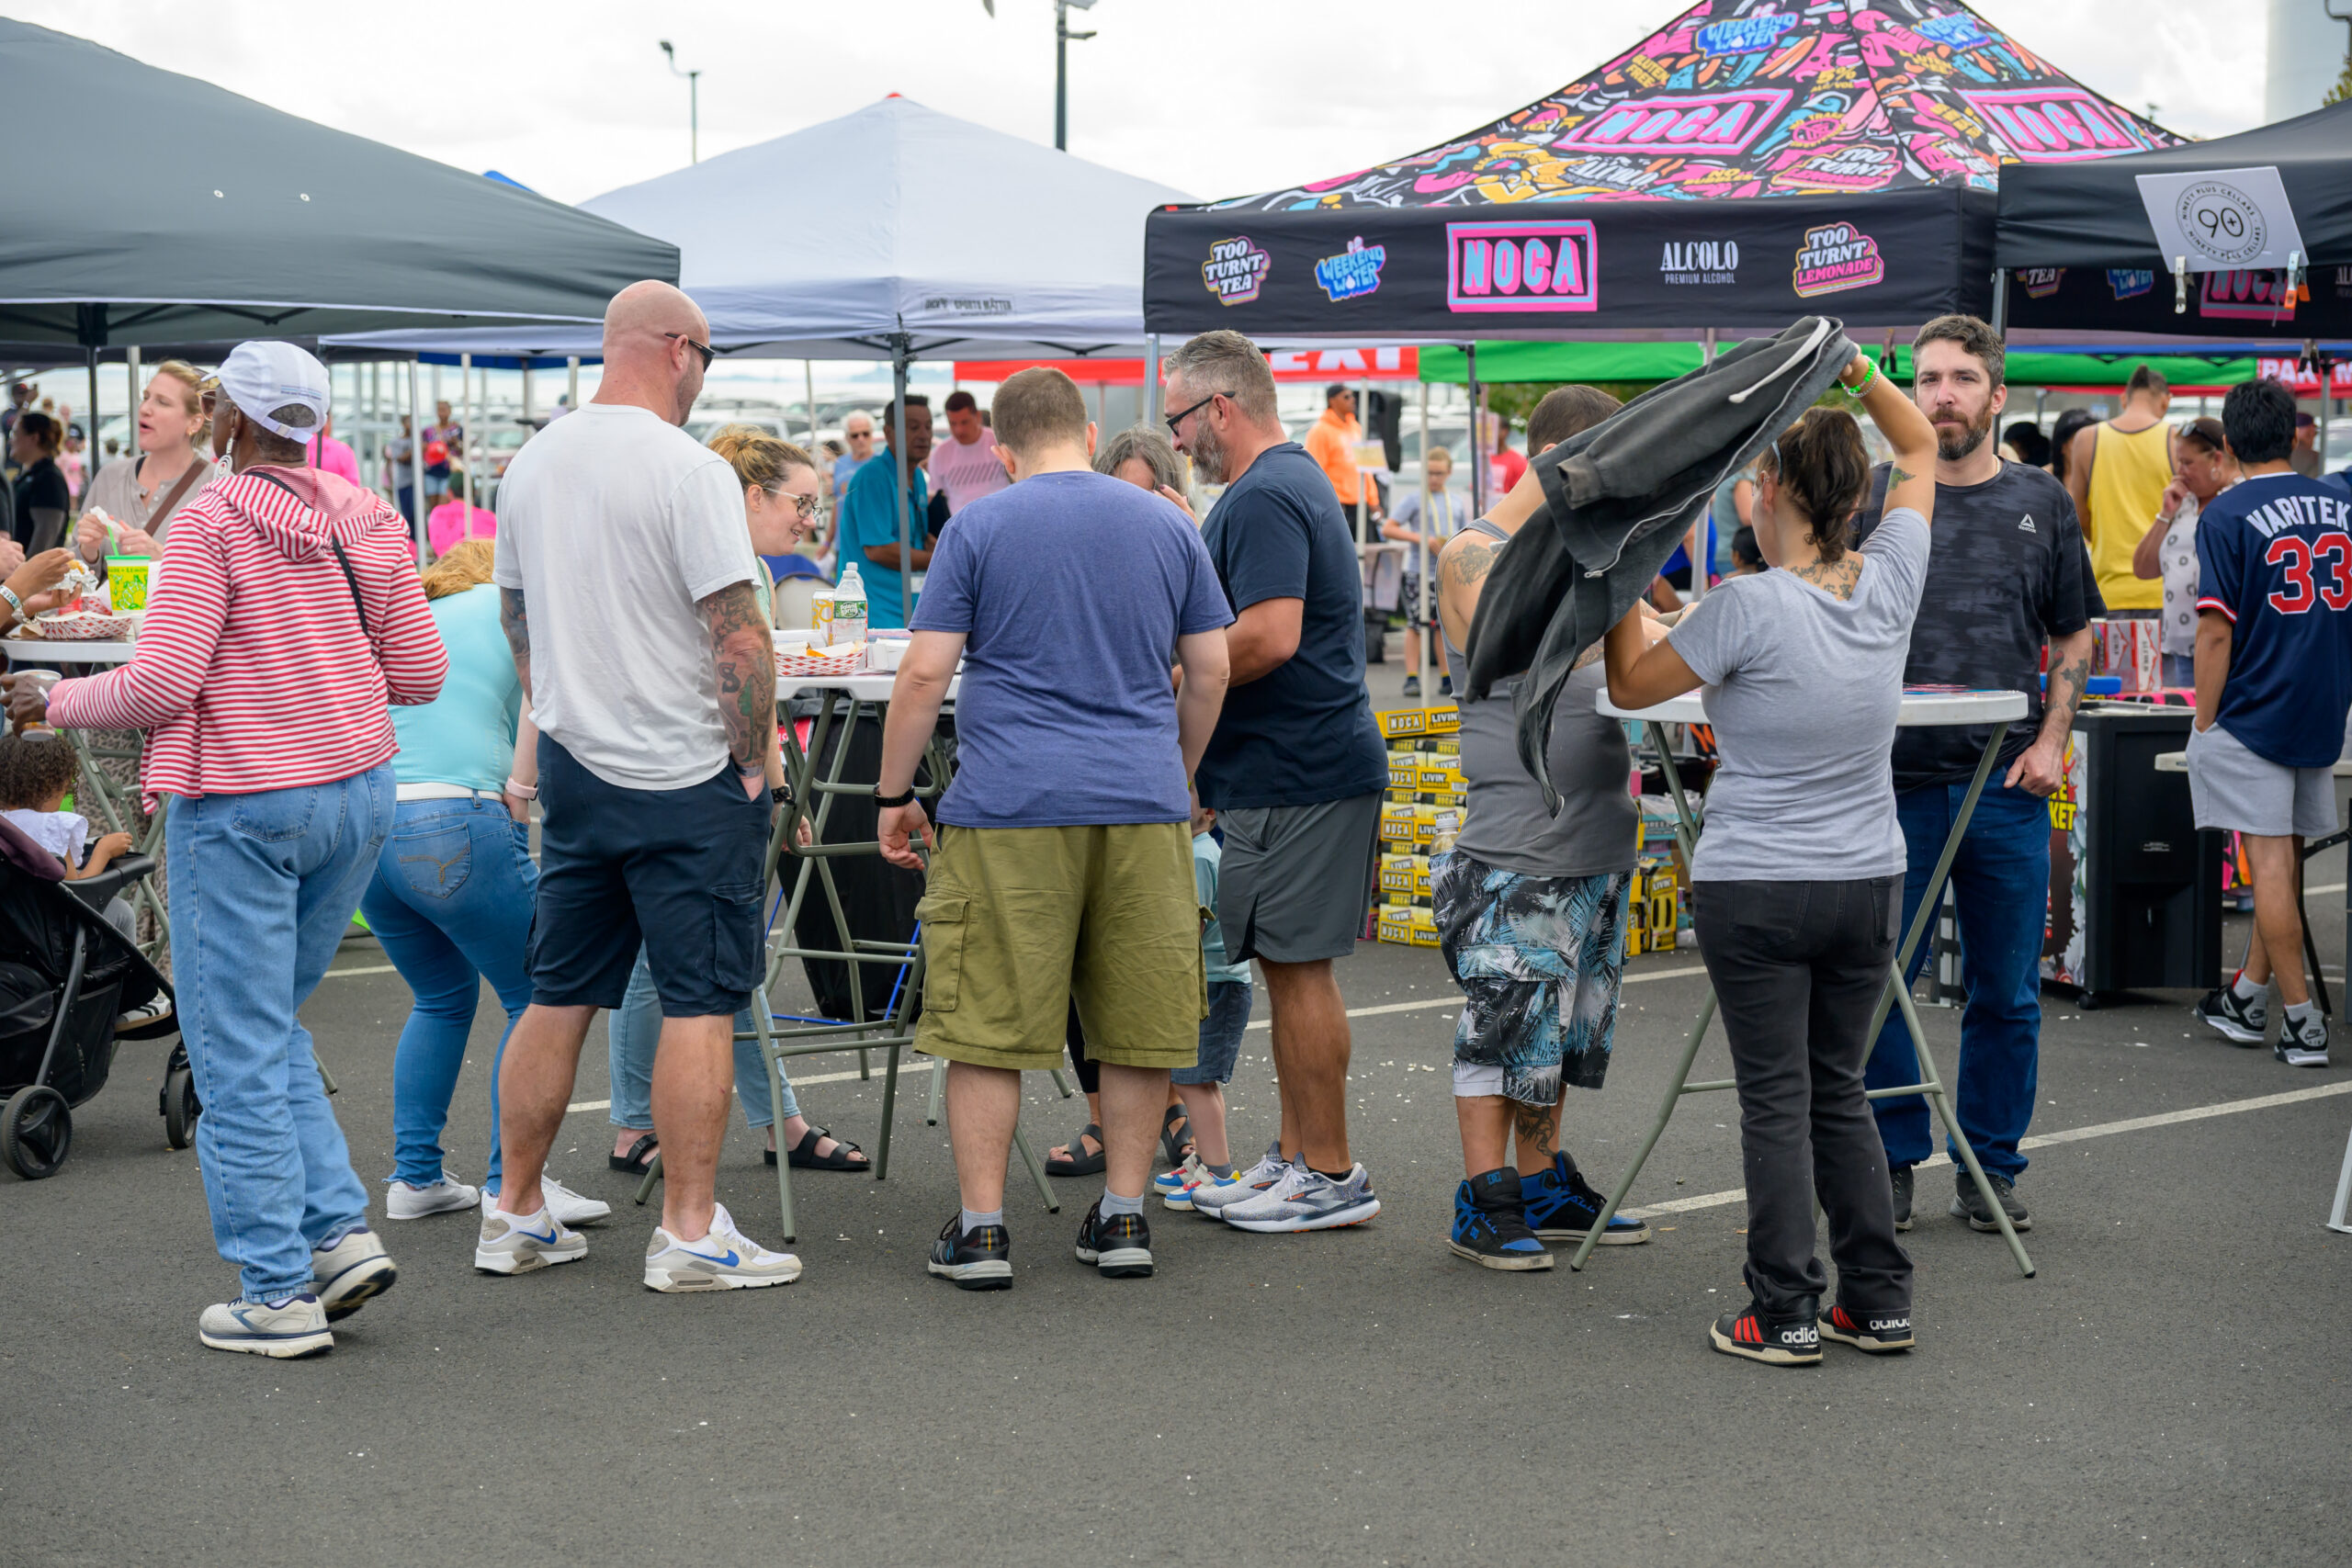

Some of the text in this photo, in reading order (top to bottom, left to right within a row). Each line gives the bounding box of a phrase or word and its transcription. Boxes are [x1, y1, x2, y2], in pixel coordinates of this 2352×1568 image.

[1585, 102, 1756, 143] NOCA
[1981, 101, 2132, 151] NOCA
[1806, 159, 1893, 176] TURNT
[1837, 147, 1890, 163] TOO
[2196, 186, 2217, 195] PLUS
[2220, 187, 2256, 216] CELLARS
[1213, 240, 1248, 263] TOO
[1809, 227, 1849, 250] TOO
[2188, 231, 2217, 254] NINETY
[2244, 226, 2261, 256] CELLARS
[1204, 254, 1264, 281] TURNT
[1319, 246, 1385, 280] WEEKEND
[1462, 237, 1584, 295] NOCA
[1660, 241, 1739, 271] ALCOLO
[1800, 241, 1868, 269] TURNT
[1219, 274, 1253, 295] TEA
[1665, 272, 1736, 285] PREMIUM ALCOHOL
[1797, 257, 1874, 285] LEMONADE
[2028, 267, 2056, 286] TEA
[2245, 496, 2352, 539] VARITEK
[2264, 531, 2352, 615] 33
[1390, 716, 1419, 729] NOCA
[1385, 822, 1409, 835] NOCA
[1385, 874, 1408, 886] NOCA
[1382, 925, 1405, 939] NOCA
